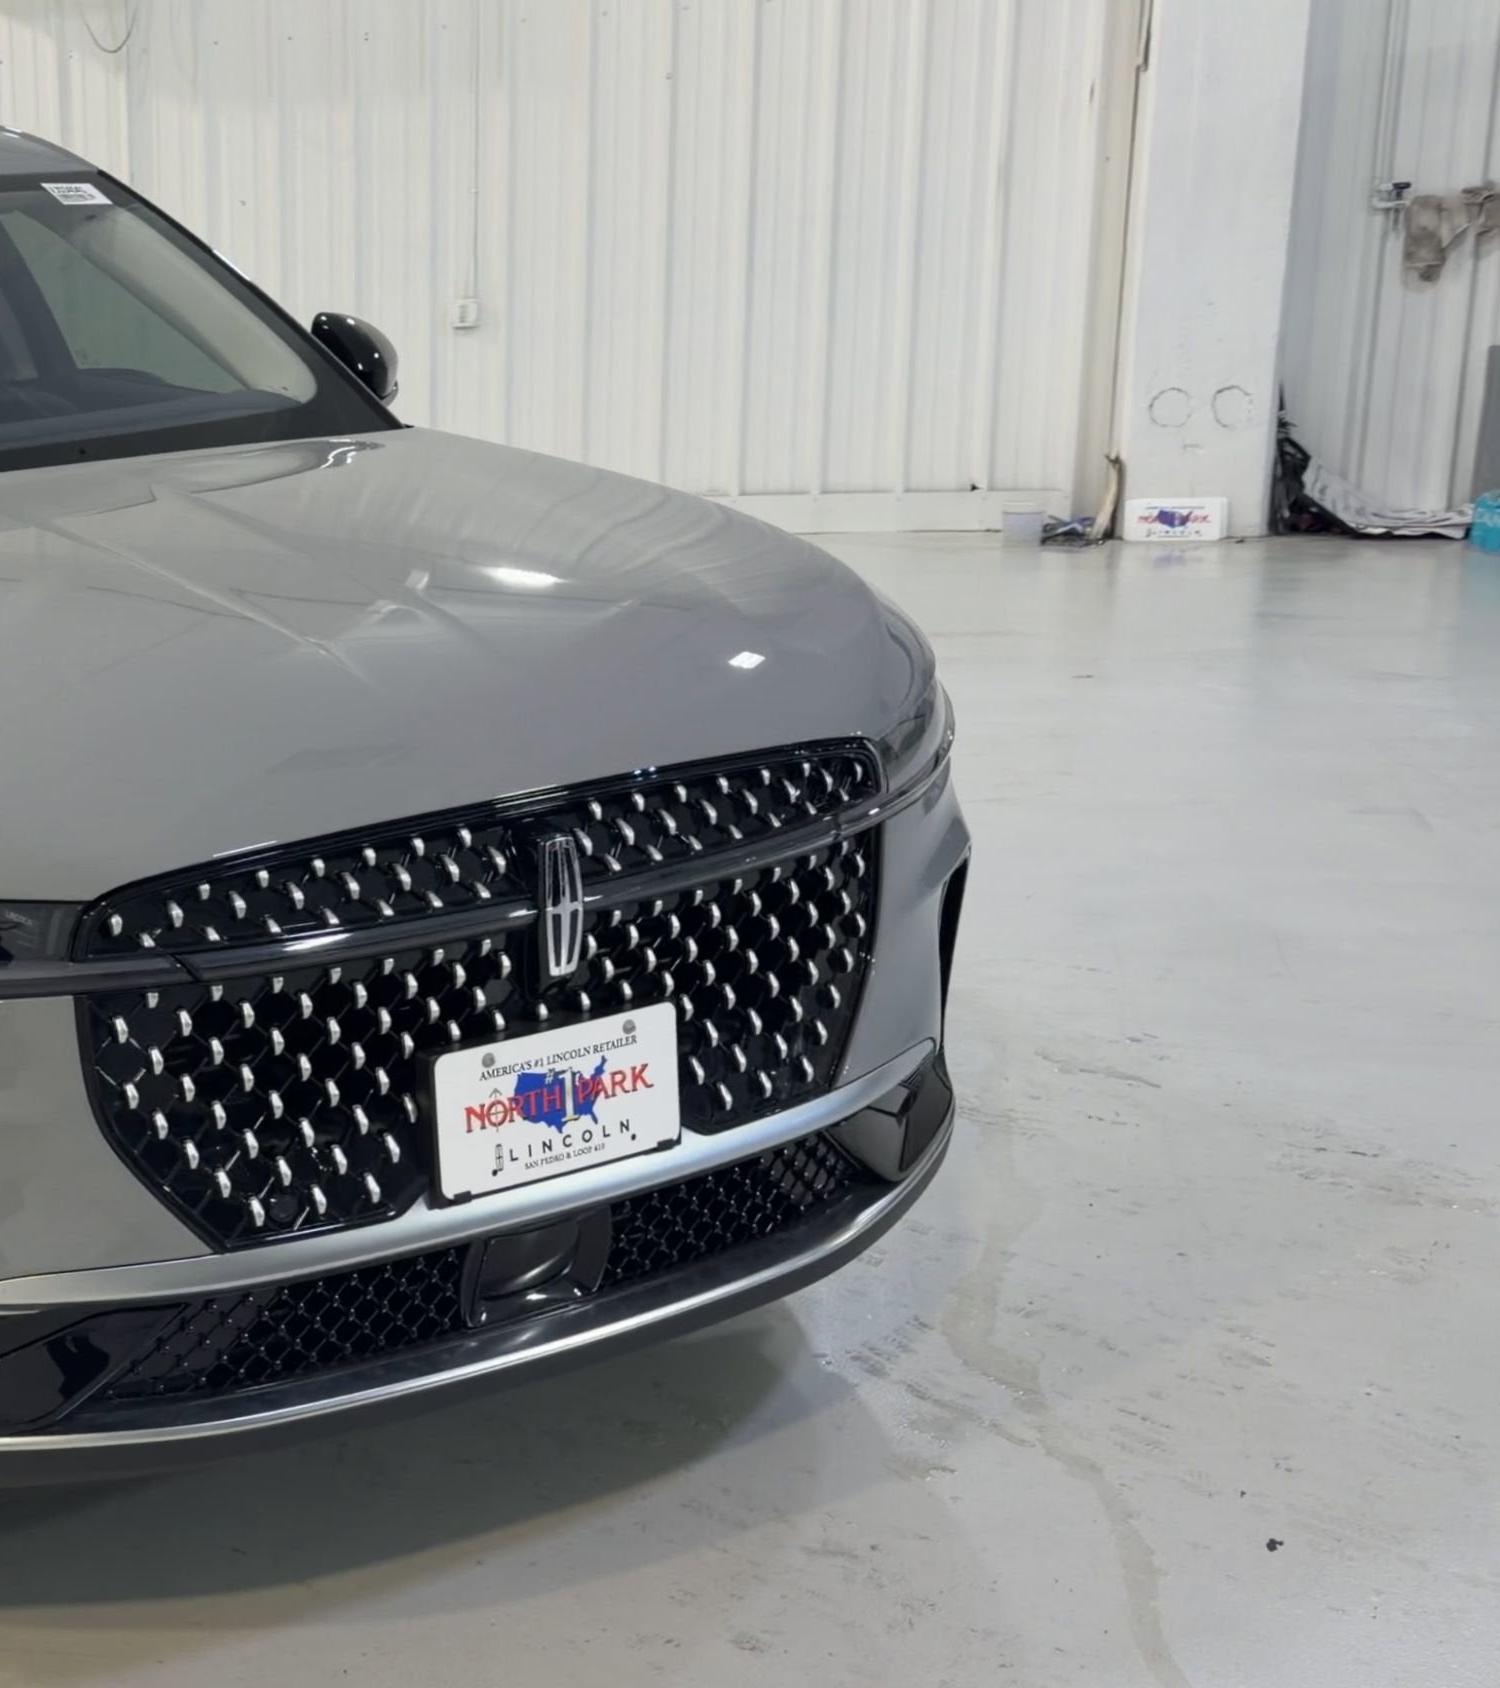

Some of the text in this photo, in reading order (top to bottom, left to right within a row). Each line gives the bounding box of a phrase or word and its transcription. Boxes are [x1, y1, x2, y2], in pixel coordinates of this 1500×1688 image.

[479, 1034, 638, 1082] AMERICA'S #1 LINCOLN RETAILER
[464, 1063, 654, 1133] NORTH PARK
[509, 1119, 631, 1162] LINCOLN
